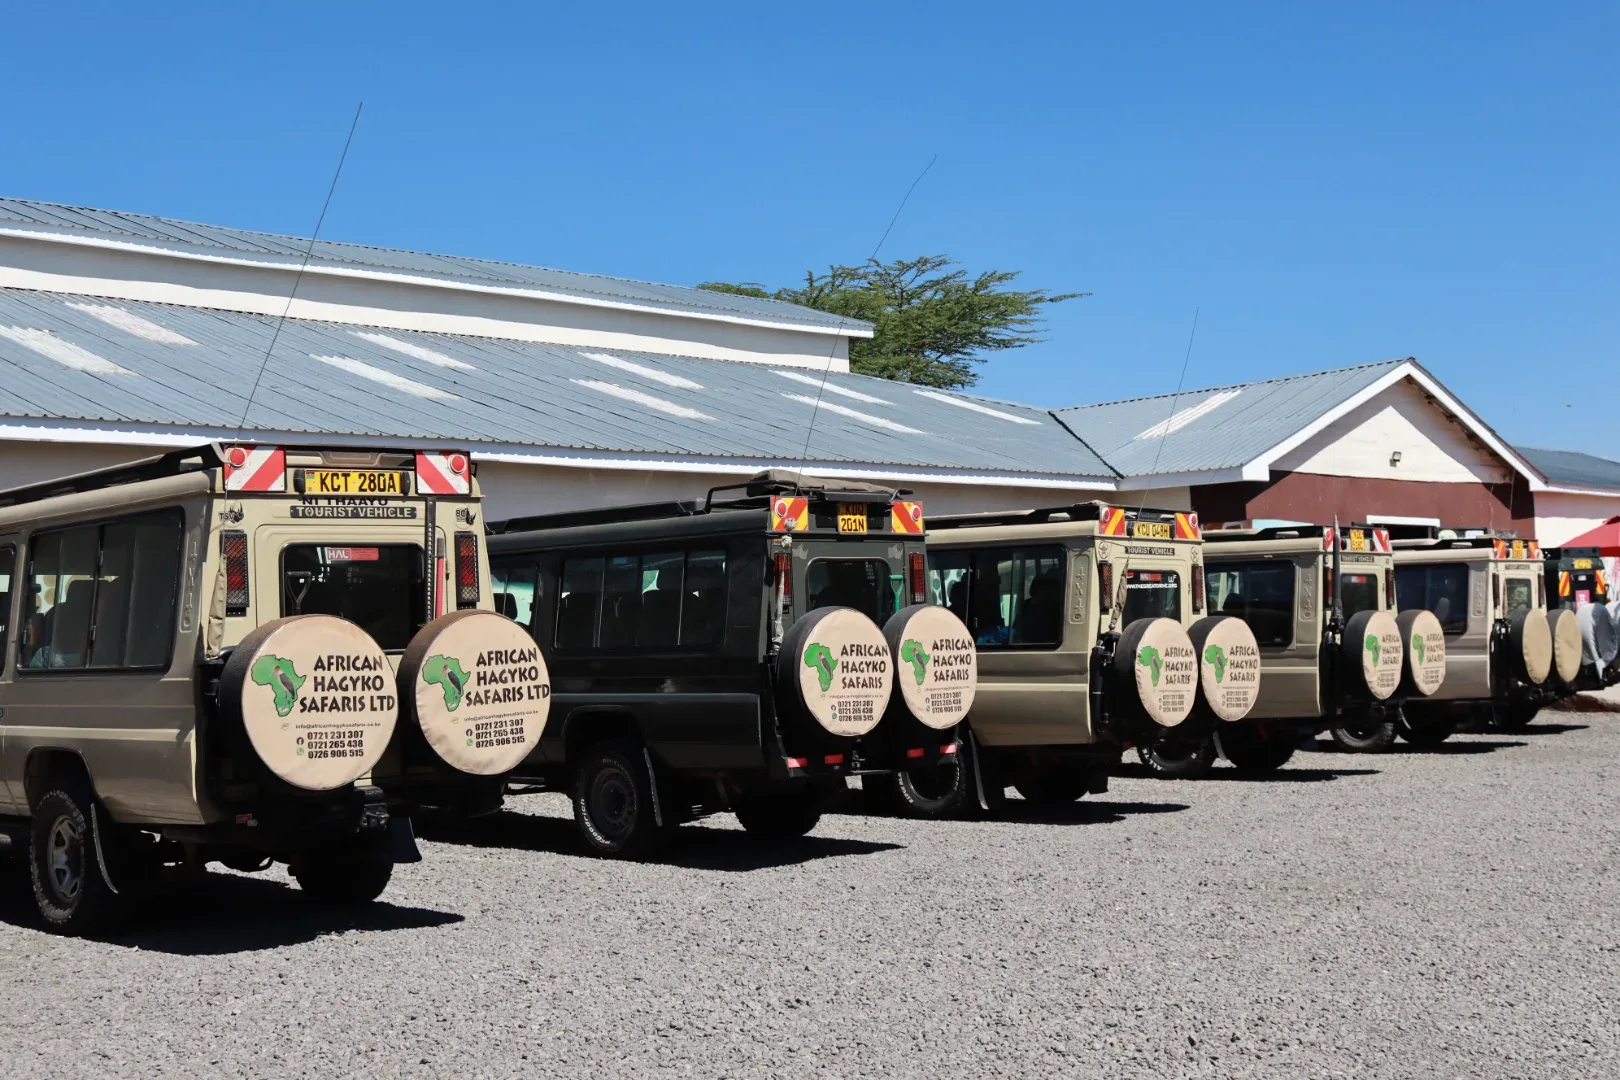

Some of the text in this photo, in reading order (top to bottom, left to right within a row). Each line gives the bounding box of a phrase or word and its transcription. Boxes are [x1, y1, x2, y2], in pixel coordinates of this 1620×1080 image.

[319, 472, 397, 493] KCT 280A
[296, 507, 412, 518] TOURIST VEHICLE
[841, 518, 865, 531] 201N
[1137, 523, 1150, 536] KCU
[841, 644, 888, 657] AFRICAN
[932, 639, 972, 651] AFRICAN
[313, 655, 383, 671] AFRICAN
[476, 647, 538, 667] AFRICAN
[933, 653, 971, 667] HAGYKO
[841, 660, 886, 674] HAGYKO
[1165, 661, 1192, 672] HAGYKO
[1229, 659, 1258, 670] HAGYKO
[476, 666, 539, 687] HAGYKO
[934, 669, 969, 682] SAFARIS
[1165, 674, 1191, 685] SAFARIS
[1229, 672, 1256, 682] SAFARIS
[313, 675, 384, 692] HAGYKO
[842, 676, 883, 689] SAFARIS
[465, 684, 550, 707] SAFARIS LTD
[299, 695, 395, 713] SAFARIS LTD
[475, 719, 524, 731] 0721 231 307
[307, 730, 363, 740] 0721 231 307
[475, 727, 524, 740] 0721 265 438
[308, 739, 363, 749] 0721 265 438
[476, 736, 525, 748] 0726 906 515
[308, 749, 364, 759] 0726 906 515
